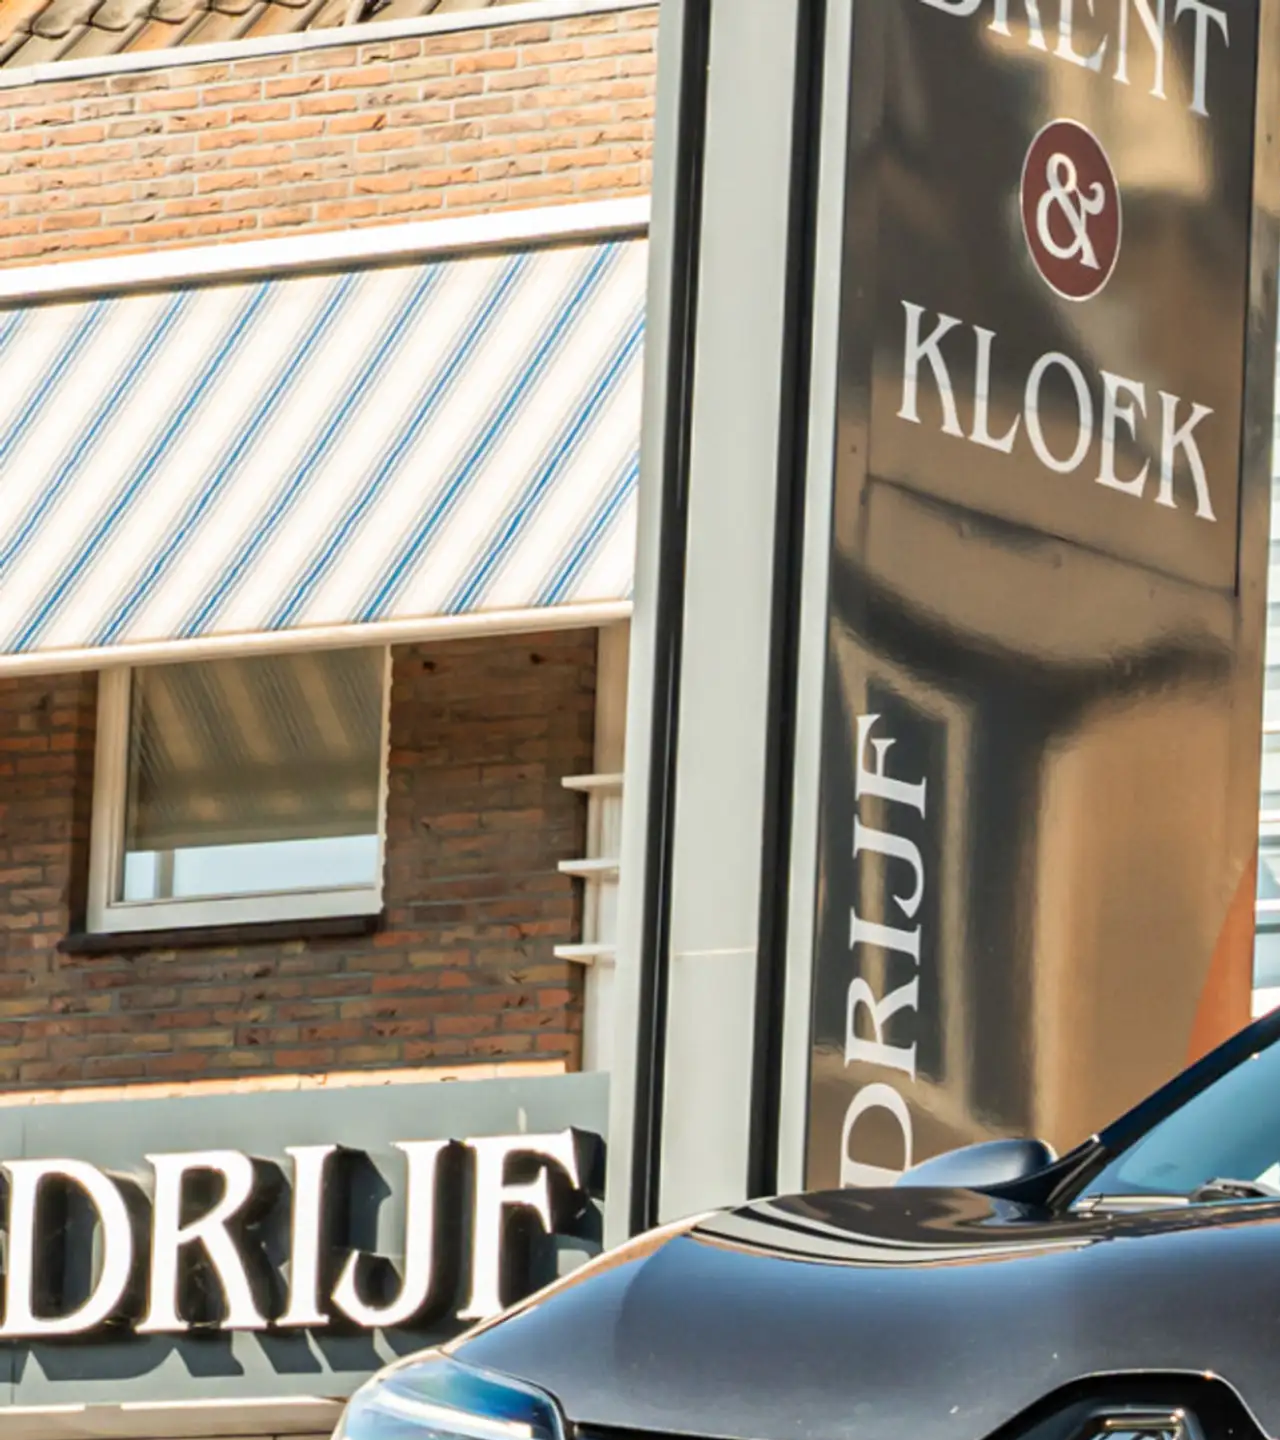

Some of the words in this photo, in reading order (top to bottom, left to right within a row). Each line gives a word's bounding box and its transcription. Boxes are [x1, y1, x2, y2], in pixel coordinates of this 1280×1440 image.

[923, 0, 1229, 117] ENT
[1036, 153, 1105, 270] &
[897, 300, 1217, 522] KLOEK
[839, 712, 928, 1188] DRIJF
